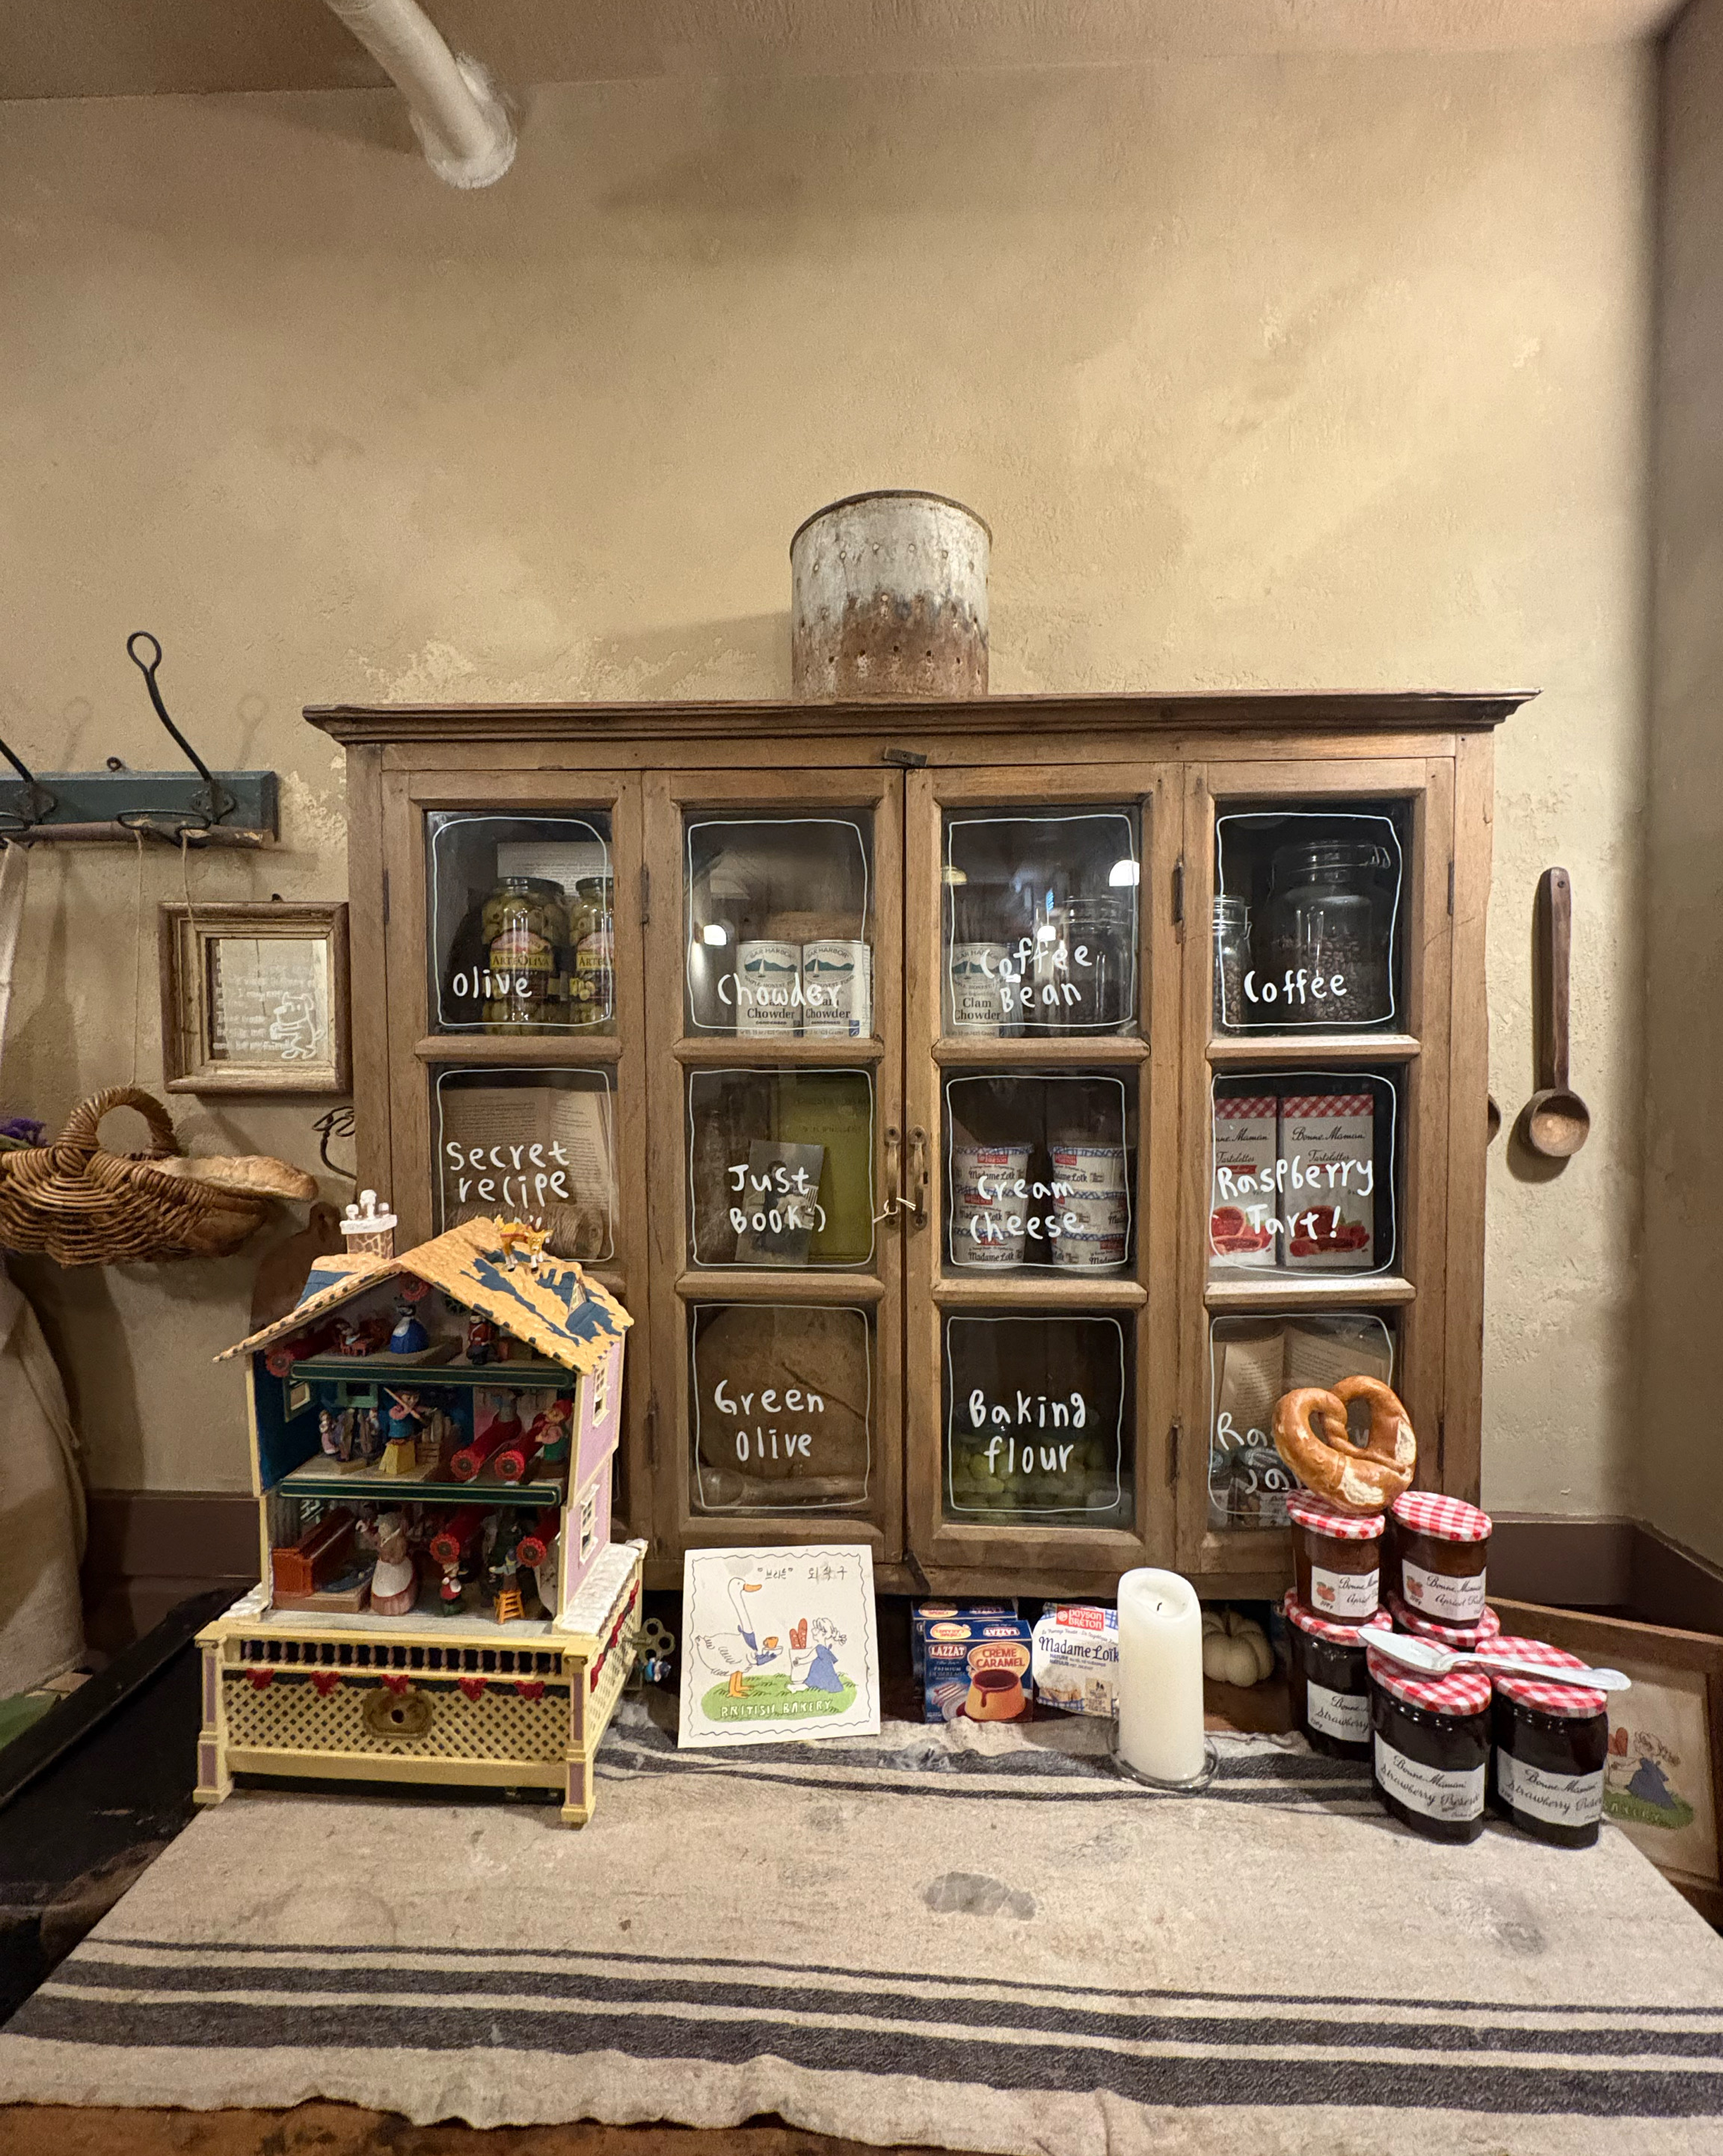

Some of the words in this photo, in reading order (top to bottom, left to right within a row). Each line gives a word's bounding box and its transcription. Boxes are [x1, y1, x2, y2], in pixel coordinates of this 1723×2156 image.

[980, 937, 1093, 979] Coffee
[718, 972, 841, 1008] Chowder
[1000, 983, 1081, 1013] Bean
[1244, 968, 1347, 1004] Coffee
[747, 1008, 795, 1019] Chowder
[805, 1008, 851, 1019] Chowder
[954, 1010, 1001, 1020] Chowder
[962, 997, 992, 1008] Clam
[1292, 1126, 1324, 1141] Bonne
[446, 1140, 570, 1171] Secret
[458, 1170, 569, 1208] recipe
[714, 1380, 824, 1415] Green
[969, 1389, 1086, 1428] Baking
[983, 1436, 1074, 1474] flour
[1339, 1576, 1366, 1590] Bonne
[1427, 1575, 1456, 1592] Bonne
[931, 1646, 965, 1656] LAZZAT
[976, 1657, 1025, 1668] CARAMEL
[1039, 1636, 1091, 1658] Madame
[1092, 1645, 1120, 1663] Loïk
[783, 1698, 833, 1714] BAKERY
[1331, 1695, 1360, 1711] Bonne
[1315, 1707, 1369, 1733] Strawberry
[1392, 1754, 1424, 1781] Bonne
[1525, 1769, 1558, 1790] Bonne
[1381, 1763, 1436, 1806] Strawberry
[1507, 1781, 1570, 1815] Strawberry
